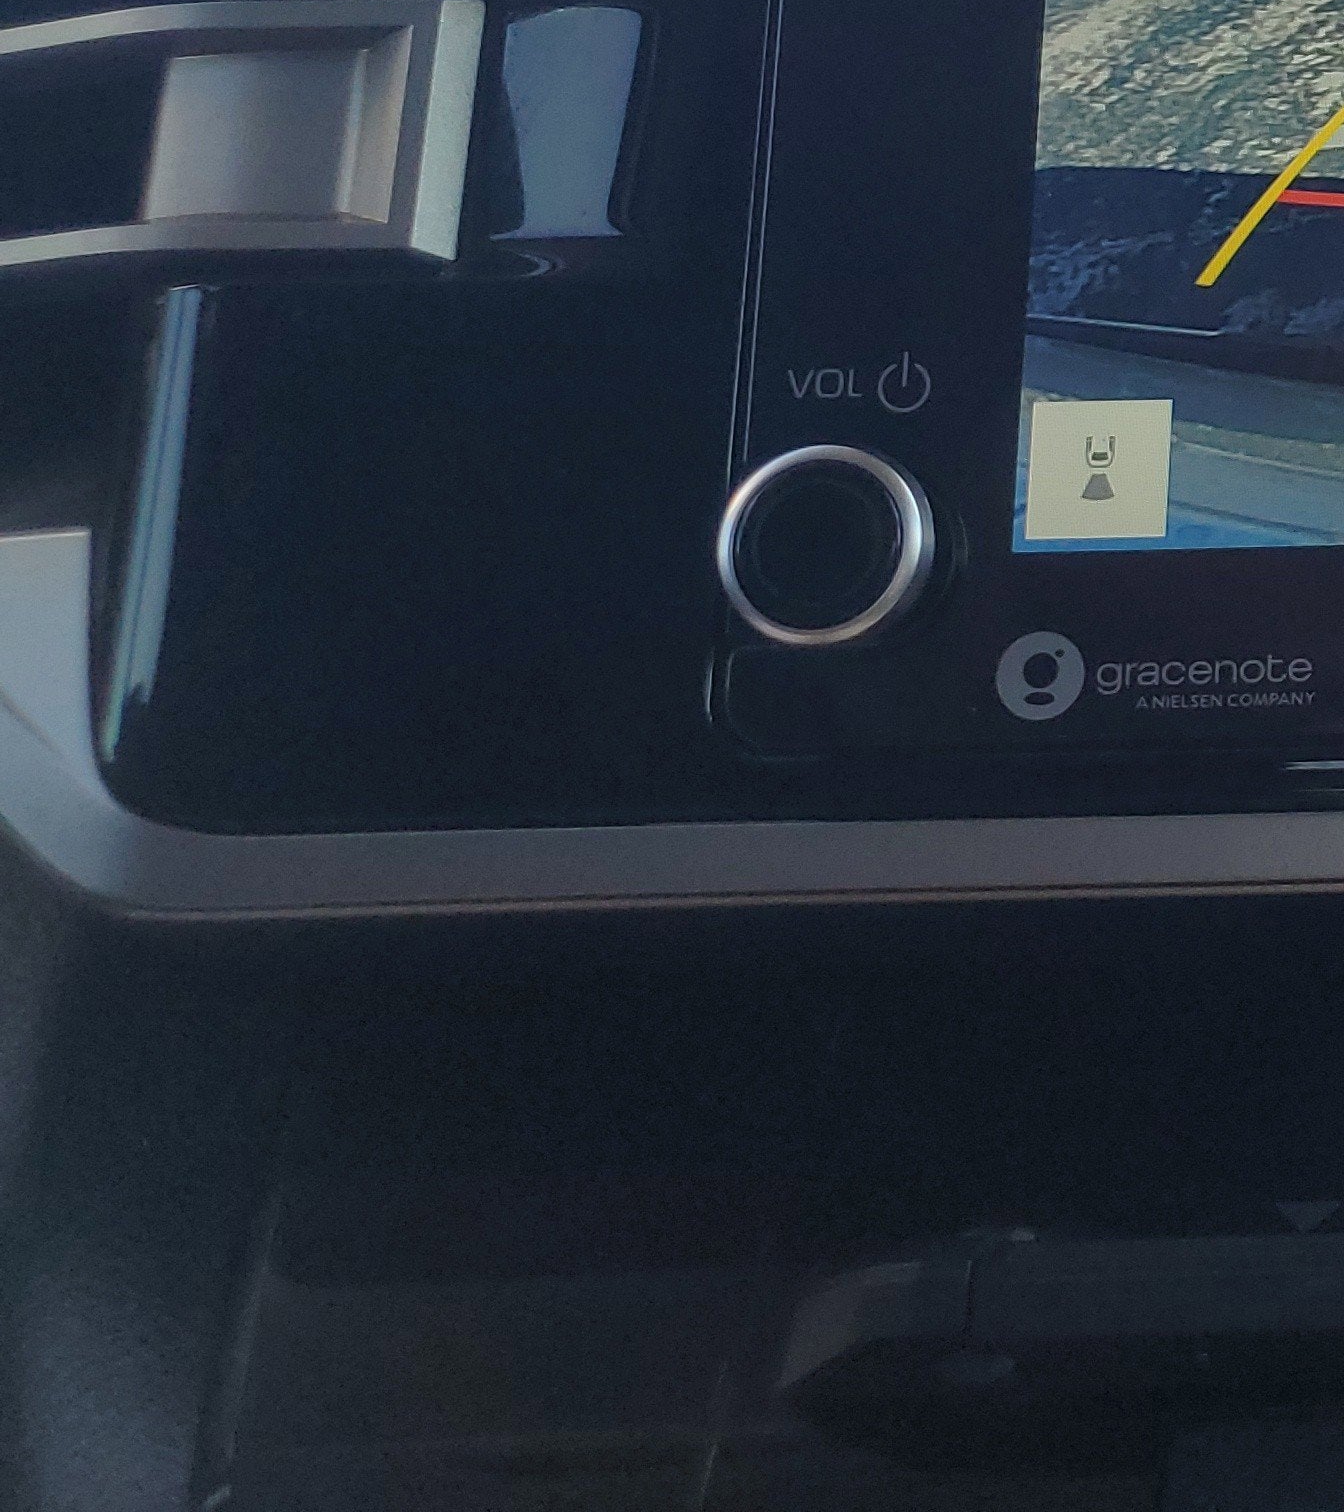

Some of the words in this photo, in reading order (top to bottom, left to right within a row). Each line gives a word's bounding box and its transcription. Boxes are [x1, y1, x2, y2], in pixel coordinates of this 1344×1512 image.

[787, 367, 864, 399] VOL
[1096, 654, 1314, 696] gracenote
[1136, 694, 1148, 709] A
[1151, 693, 1224, 709] NIELSEN
[1226, 691, 1316, 708] COMPANY
